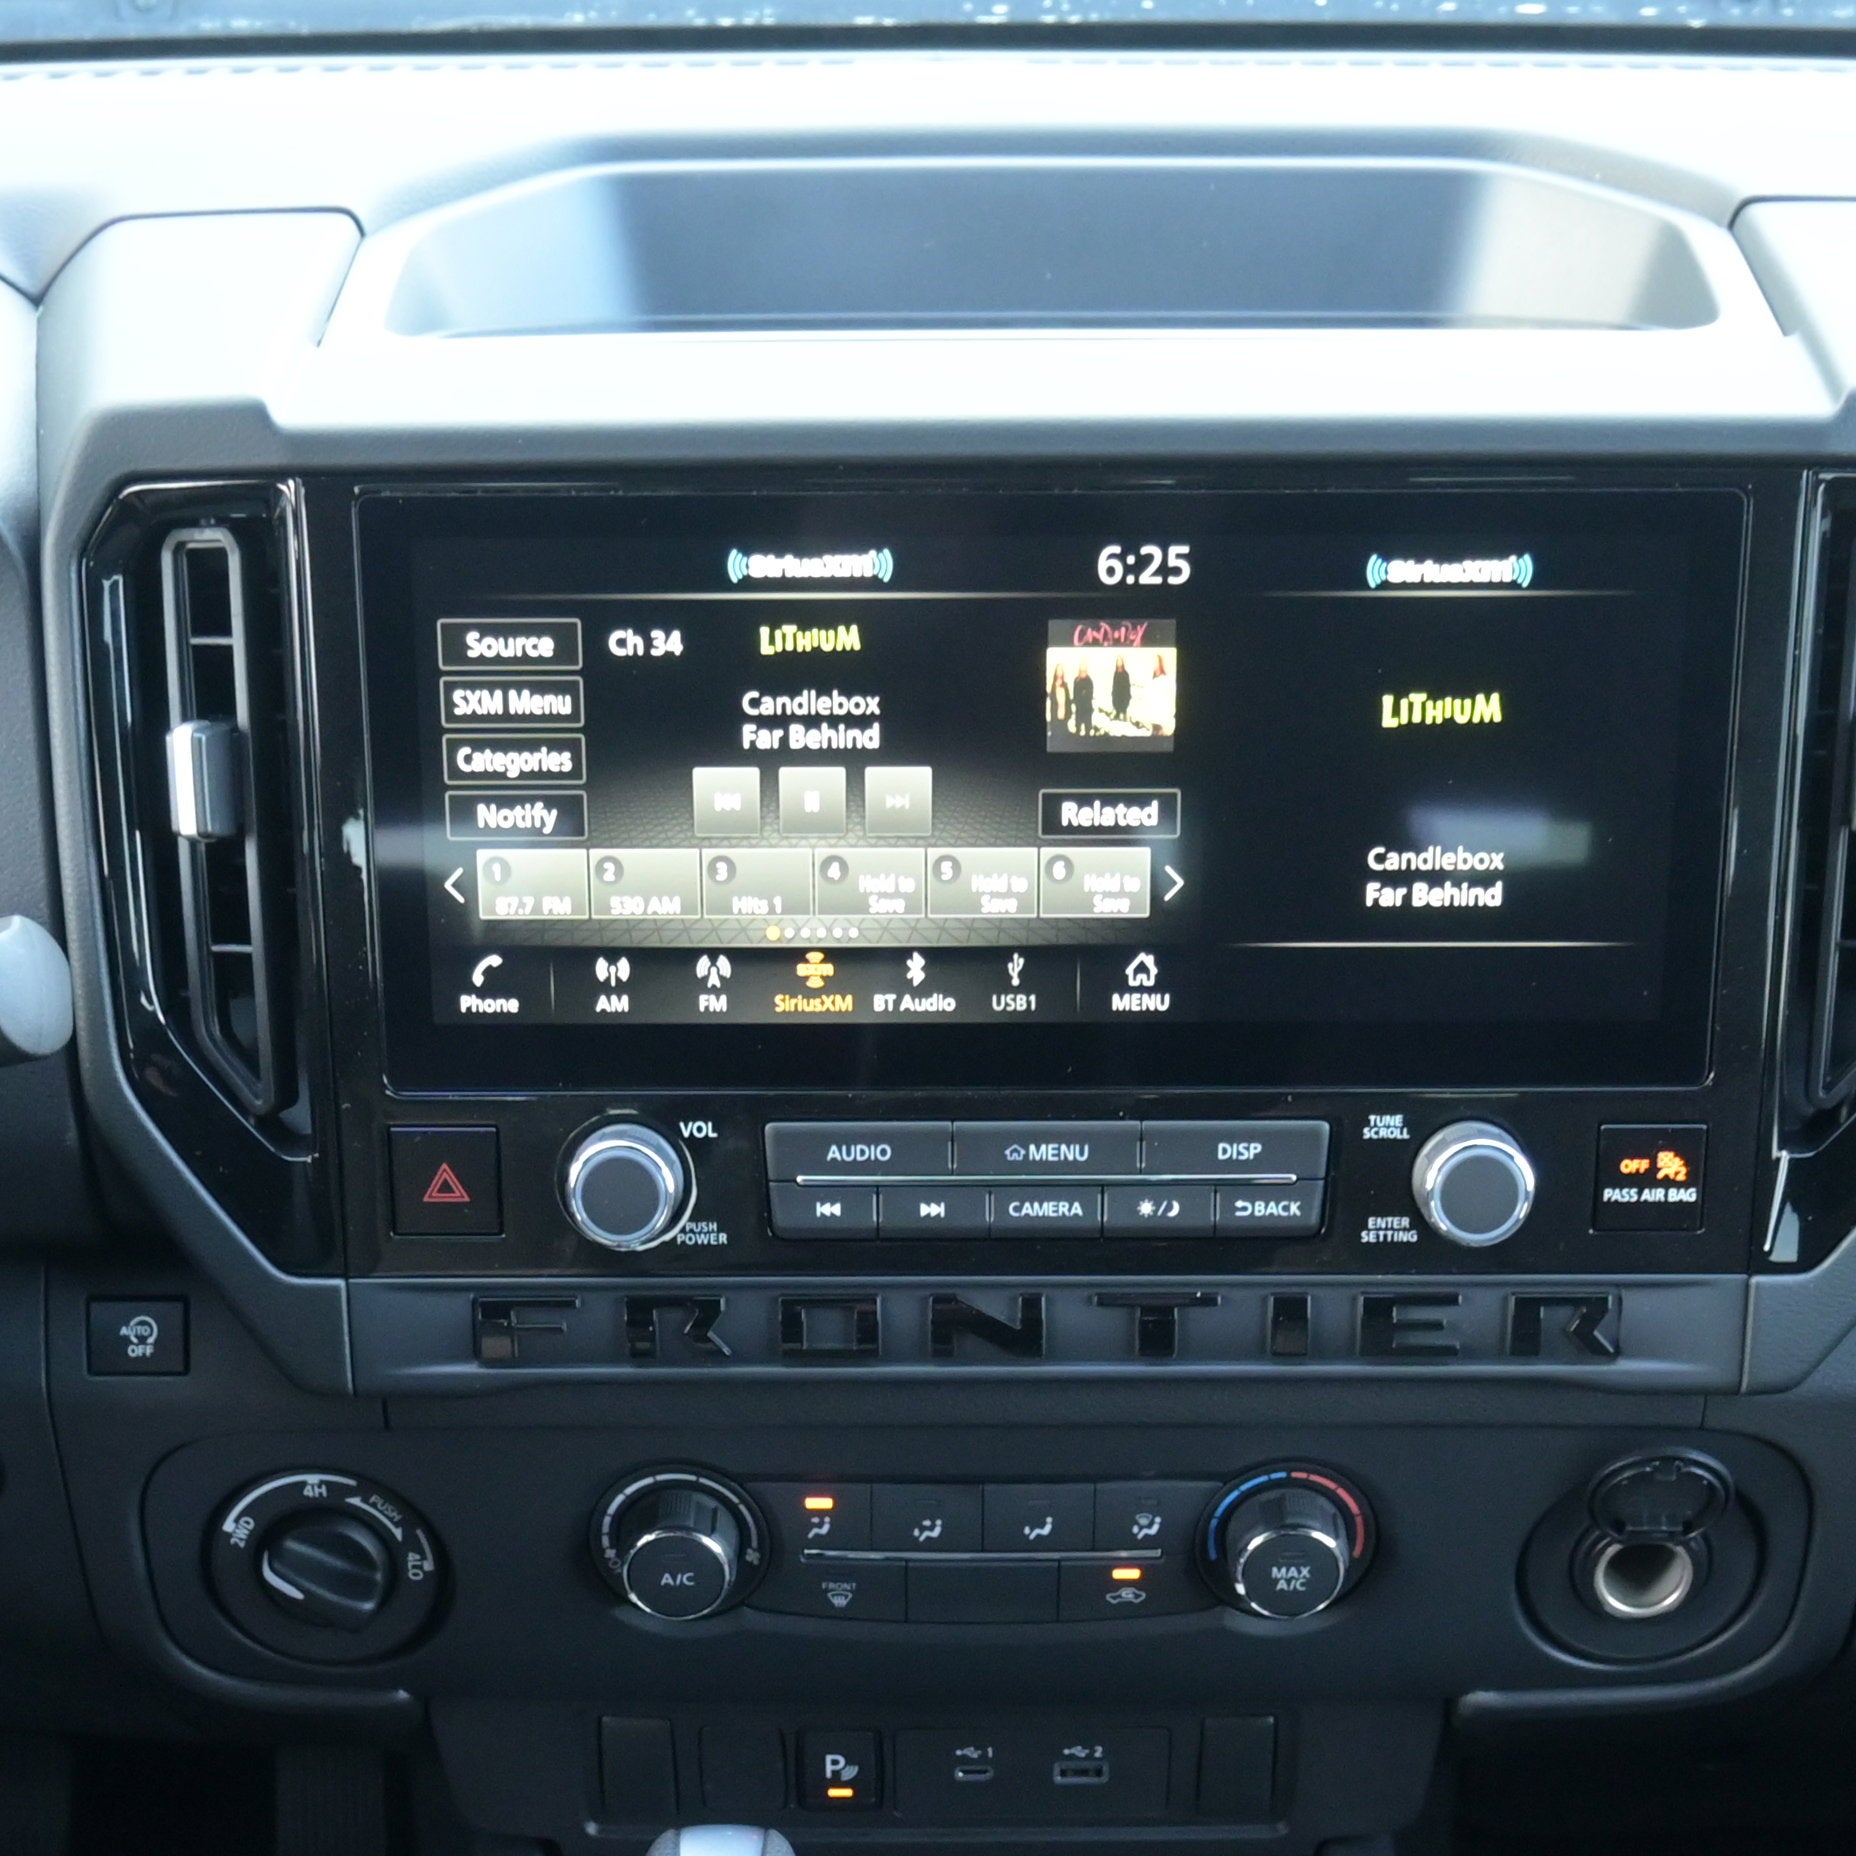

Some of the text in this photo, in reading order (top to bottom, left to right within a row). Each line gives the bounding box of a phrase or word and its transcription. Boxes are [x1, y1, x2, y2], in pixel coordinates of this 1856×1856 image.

[1096, 544, 1192, 585] 6:25
[466, 631, 554, 658] Source
[608, 630, 683, 656] Ch 34
[453, 689, 572, 716] SXM Menu
[742, 689, 881, 716] Candlebox
[742, 723, 880, 750] Far Behind
[457, 746, 572, 778] Categories
[477, 802, 558, 834] Notify
[1061, 800, 1158, 828] Related
[1367, 846, 1504, 871] Candlebox
[491, 862, 502, 882] 1
[602, 862, 616, 882] 2
[715, 862, 728, 882] 3
[827, 861, 841, 881] 4
[940, 861, 953, 881] 5
[1052, 860, 1066, 880] 6
[1365, 881, 1502, 908] Far Behind
[609, 896, 681, 915] 530 AM
[459, 994, 520, 1013] Phone
[596, 995, 630, 1013] AM
[699, 995, 727, 1013] FM
[774, 994, 853, 1012] SiriusXM
[873, 994, 956, 1013] BT Audio
[992, 994, 1037, 1012] USB1
[1112, 994, 1170, 1012] MENU
[680, 1121, 718, 1139] VOL
[1368, 1115, 1403, 1127] TUNE
[1363, 1127, 1410, 1140] SCROLL
[826, 1144, 892, 1162] AUDIO
[1028, 1144, 1089, 1162] MENU
[1217, 1142, 1262, 1160] DISP
[1620, 1159, 1651, 1174] OFF
[1603, 1187, 1697, 1202] PASS AIR BAG
[1008, 1201, 1083, 1218] CAMERA
[1254, 1200, 1301, 1218] BACK
[685, 1222, 718, 1233] PUSH
[1367, 1217, 1410, 1230] ENTER
[676, 1233, 728, 1246] POWER
[1360, 1229, 1418, 1243] SETTING
[473, 1291, 1621, 1360] FRONTIER
[127, 1344, 154, 1357] OFF
[303, 1485, 327, 1498] 4H
[369, 1494, 403, 1522] PUSH
[230, 1516, 255, 1548] 2WD
[407, 1551, 424, 1581] 4LO
[1271, 1566, 1311, 1579] MAX
[660, 1572, 695, 1586] A/C
[822, 1581, 856, 1591] FRONT
[1276, 1579, 1307, 1591] A/C
[987, 1747, 993, 1758] 1
[1094, 1746, 1103, 1758] 2
[825, 1754, 845, 1779] P
